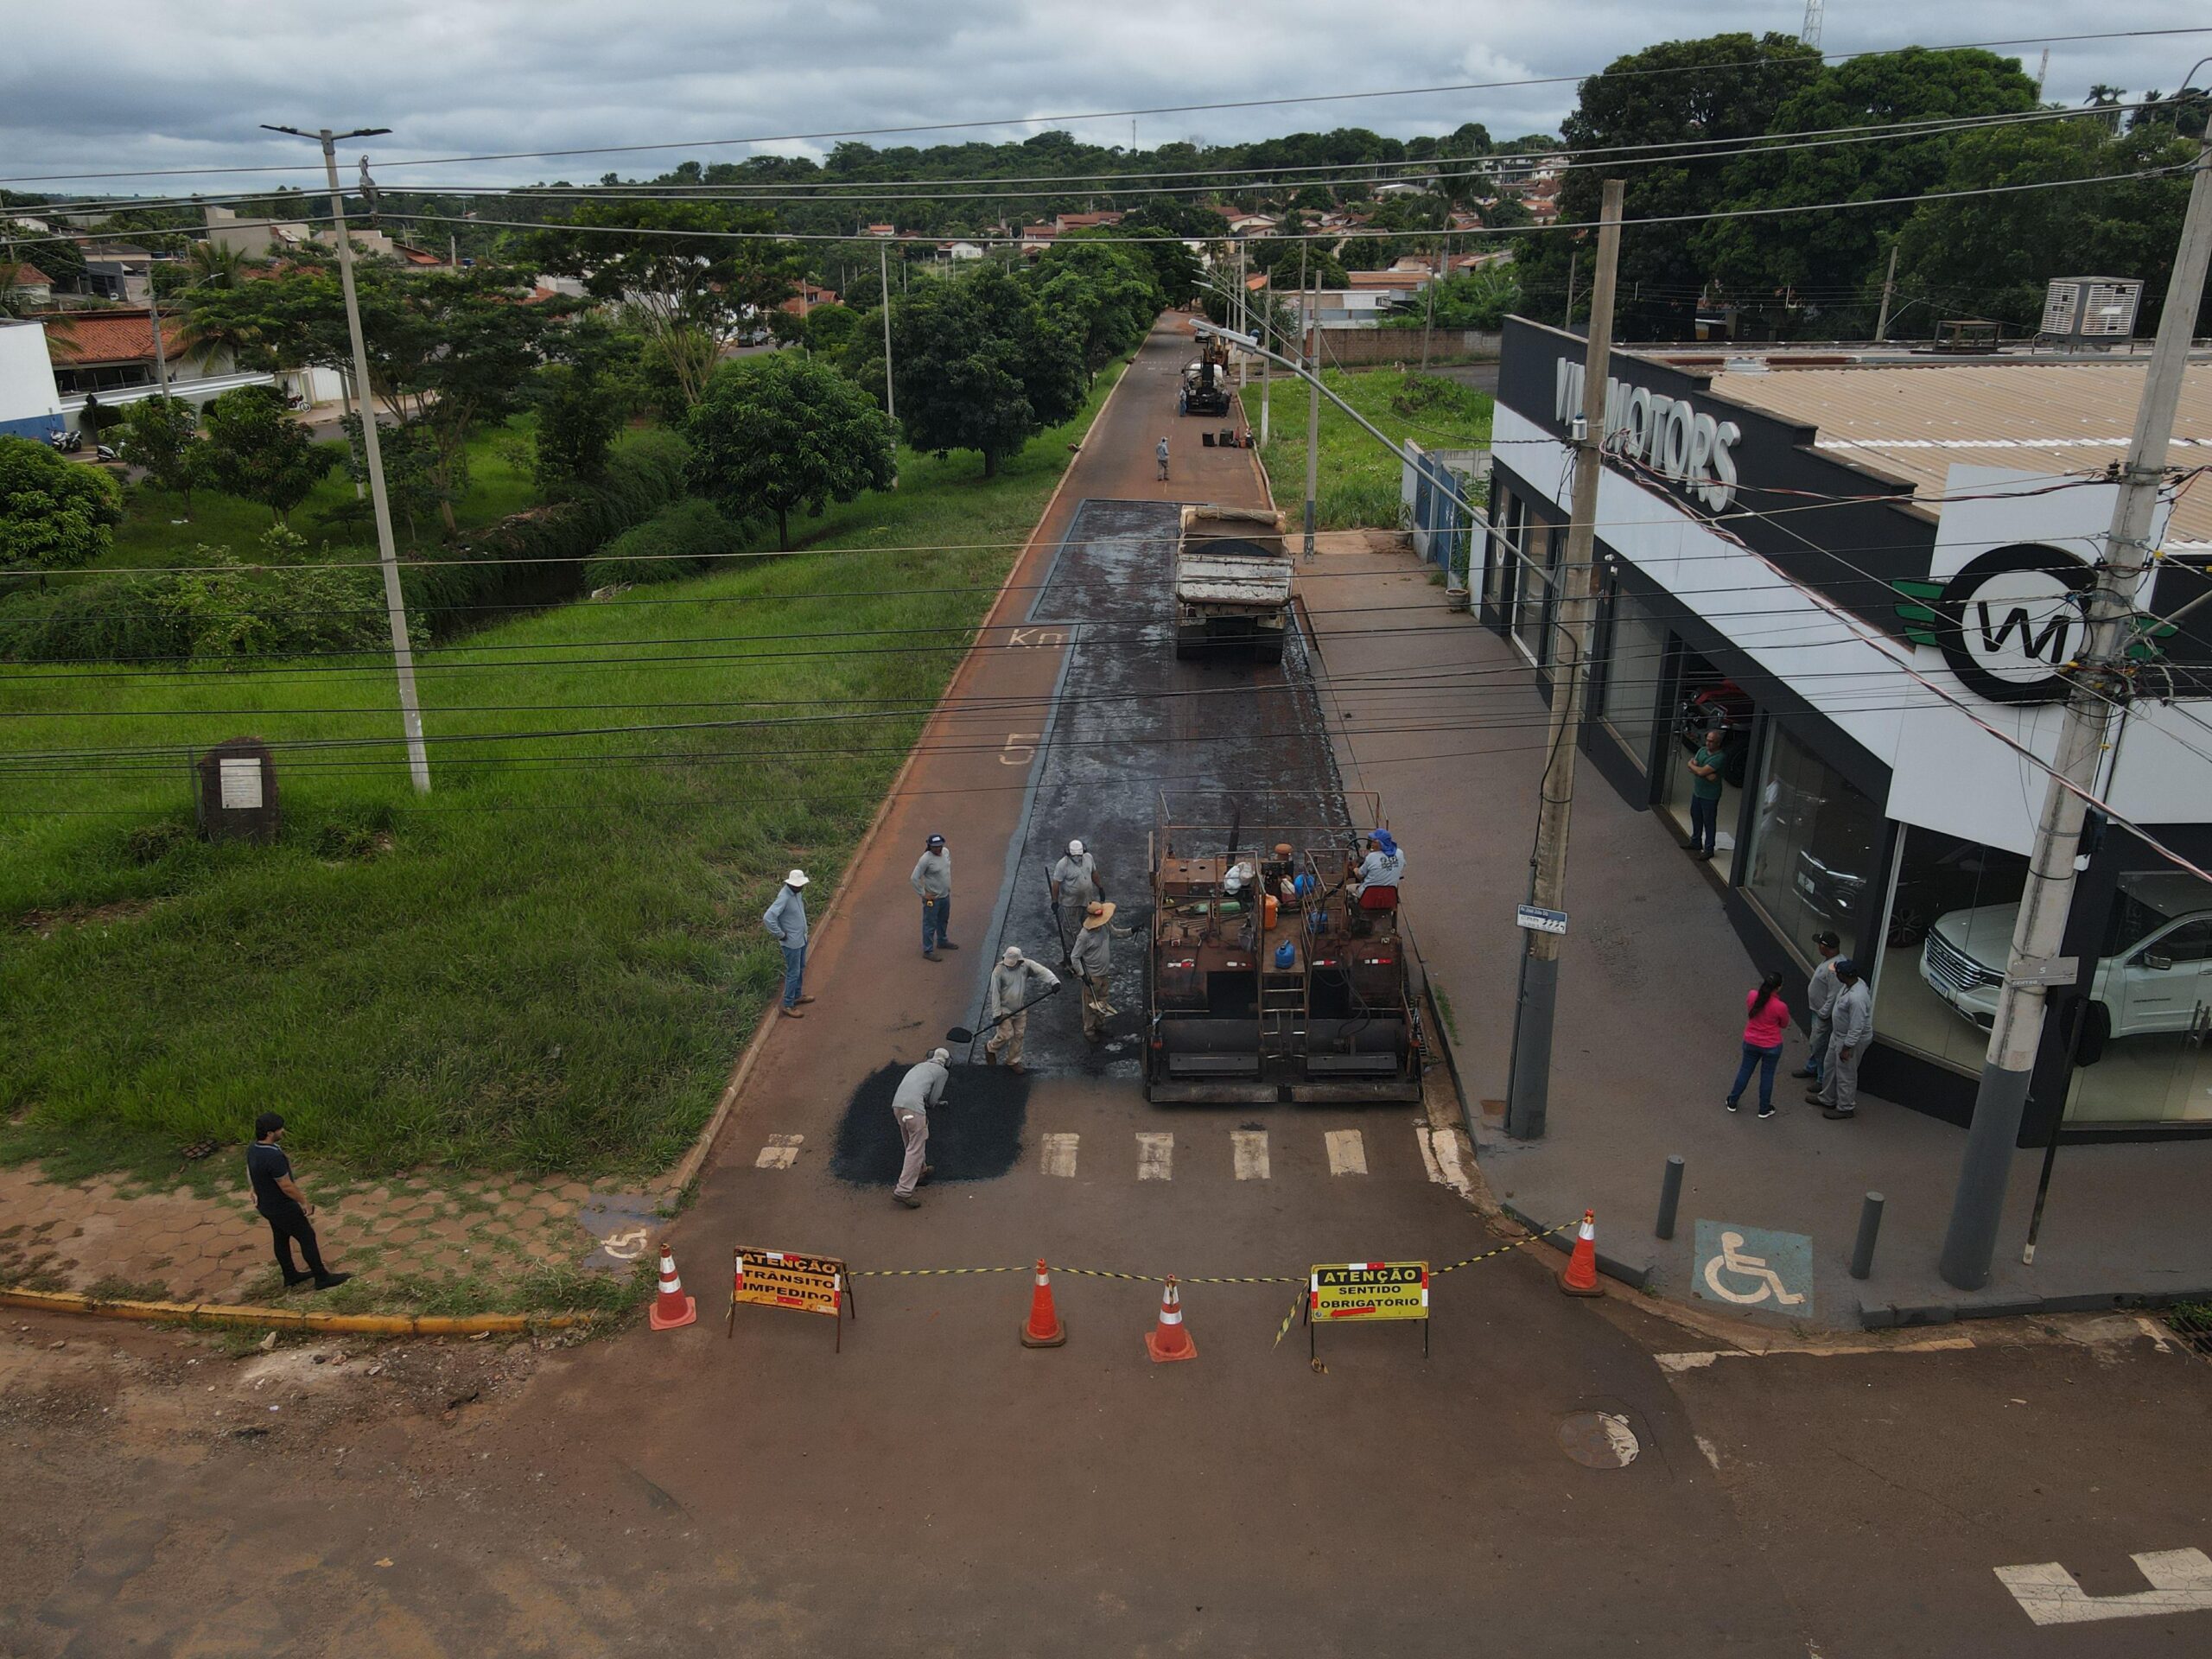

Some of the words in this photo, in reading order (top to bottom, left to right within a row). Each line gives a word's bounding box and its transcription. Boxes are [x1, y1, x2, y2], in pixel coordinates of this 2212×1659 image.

[742, 1253, 836, 1274] ATENÇÃO
[743, 1269, 835, 1289] TRÂNSITO
[1323, 1268, 1416, 1284] ATENÇÃO
[1338, 1286, 1402, 1295] SENTIDO
[1320, 1298, 1420, 1308] OBRIGATÓRIO
